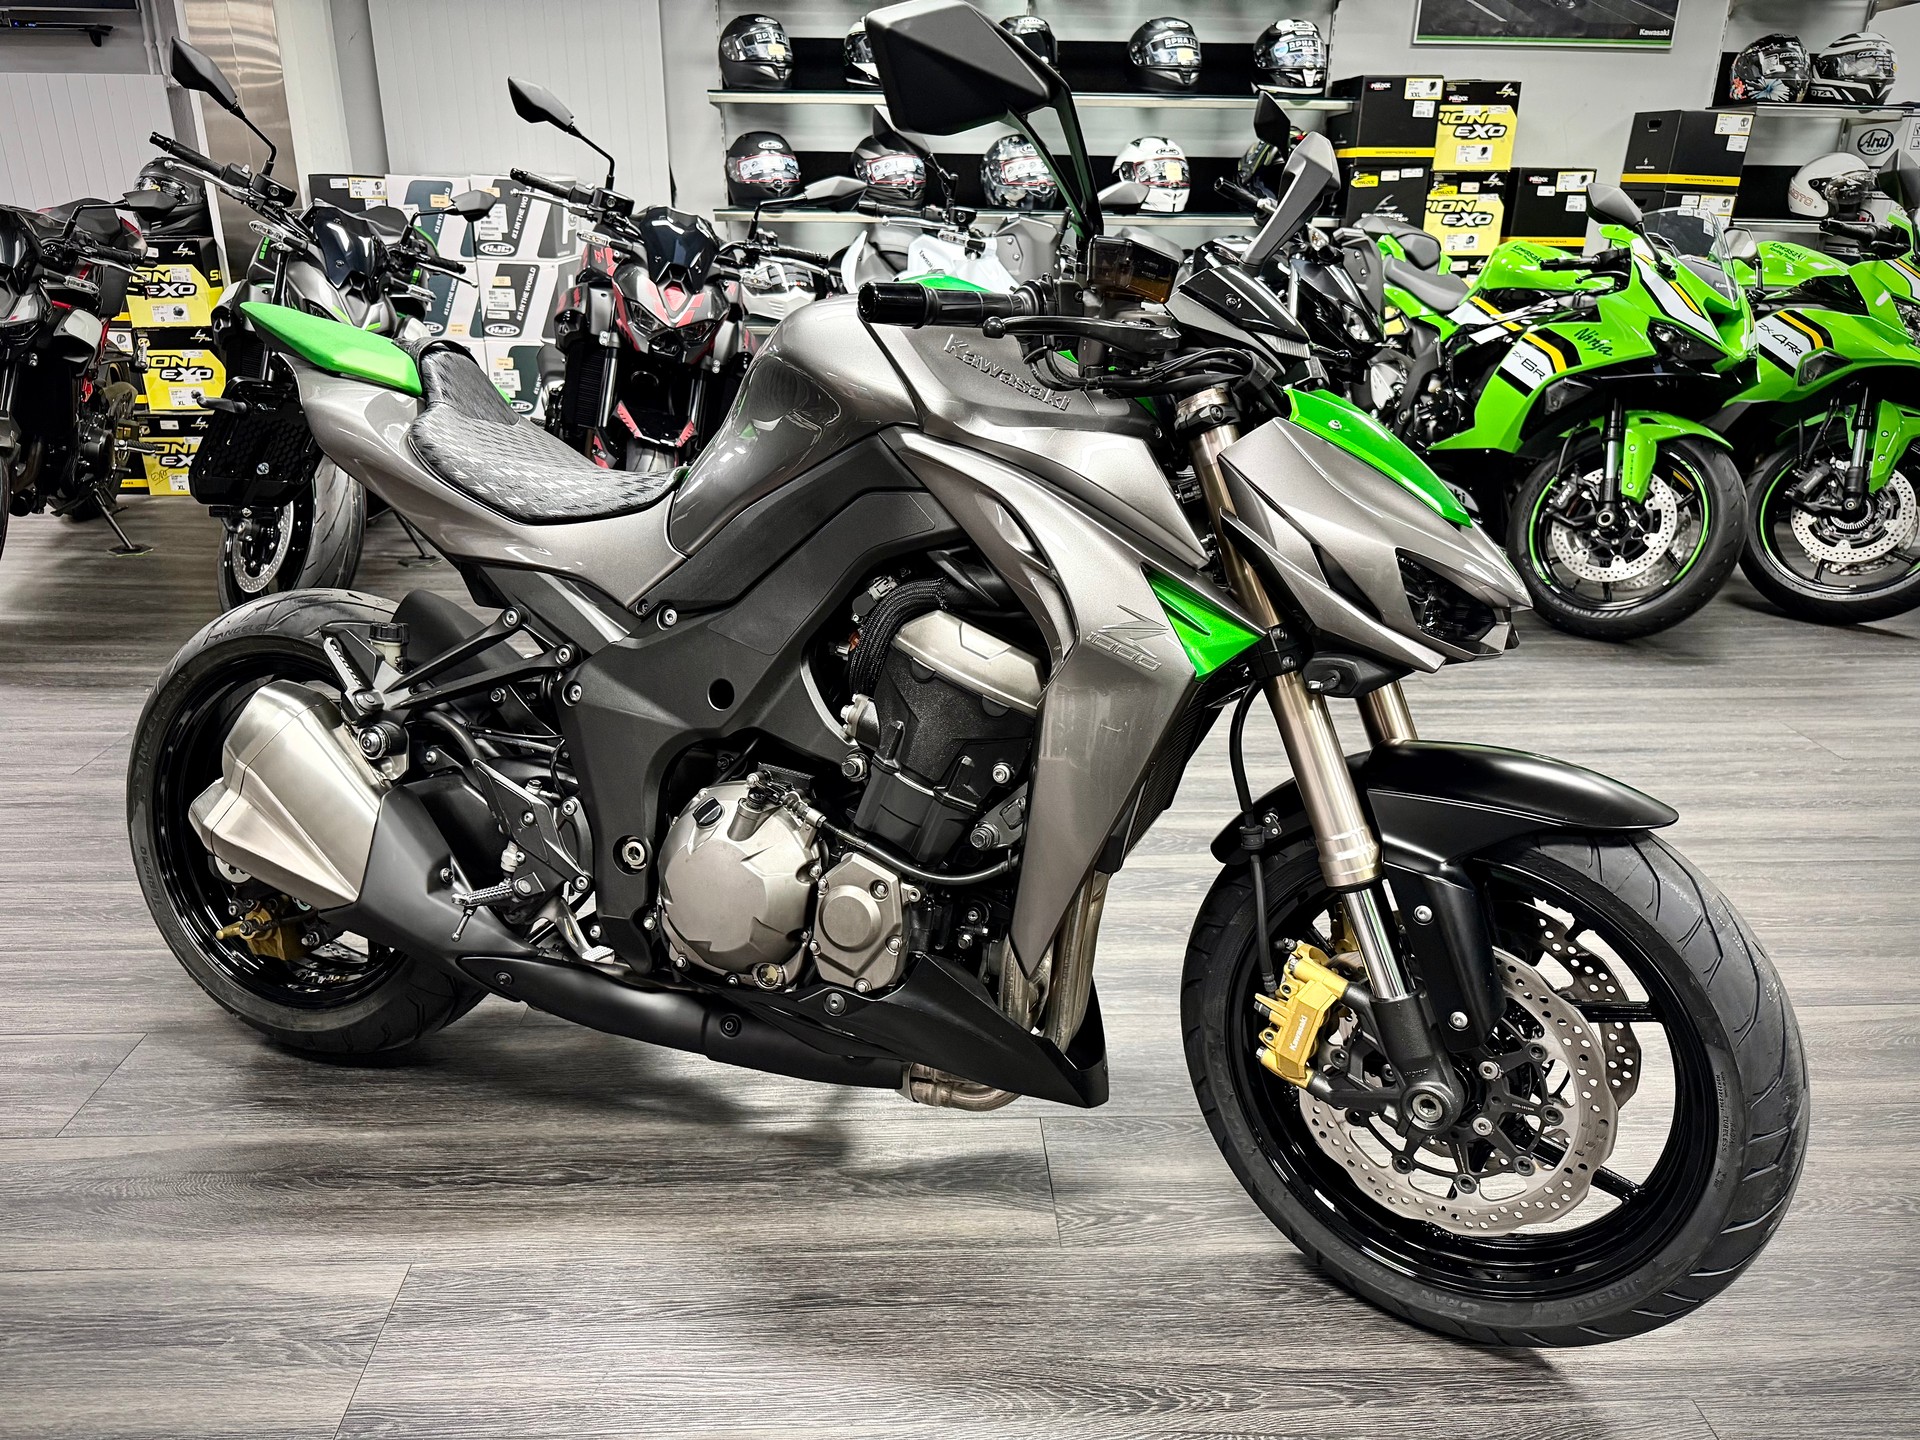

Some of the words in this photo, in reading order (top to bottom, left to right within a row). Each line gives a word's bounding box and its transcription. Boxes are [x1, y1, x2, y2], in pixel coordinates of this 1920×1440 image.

[1639, 28, 1670, 36] Kawasaki
[1288, 40, 1314, 49] RPHA
[1454, 124, 1506, 139] EXO
[1860, 132, 1890, 148] Arai
[516, 208, 525, 222] THE
[1442, 212, 1493, 226] EXO
[484, 245, 510, 253] HJC
[144, 283, 196, 297] EXO
[521, 291, 529, 304] THE
[525, 267, 537, 291] WORLD
[489, 326, 516, 334] HJC
[1574, 328, 1613, 356] Ninja
[161, 368, 212, 380] EXO
[944, 334, 1072, 412] Kawasaki
[161, 454, 196, 467] EX
[1289, 1014, 1308, 1052] Kawasaki
